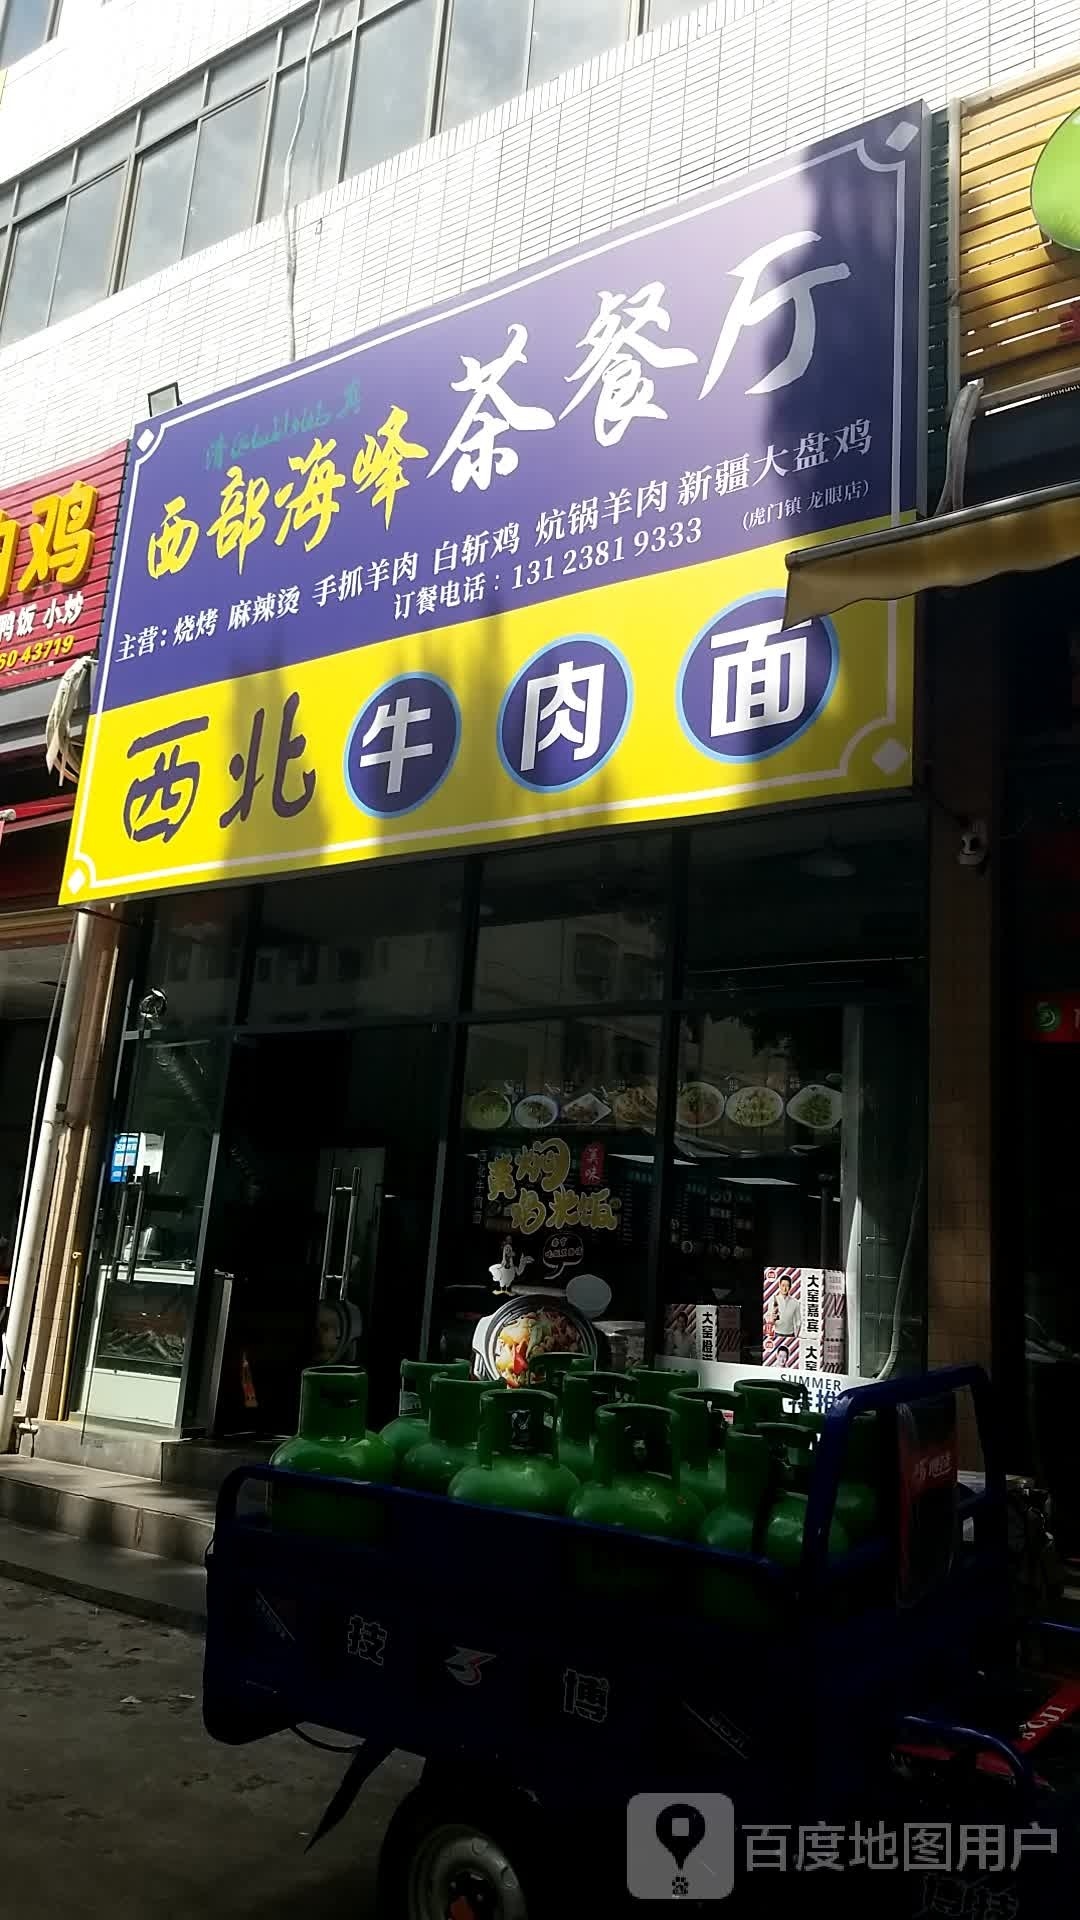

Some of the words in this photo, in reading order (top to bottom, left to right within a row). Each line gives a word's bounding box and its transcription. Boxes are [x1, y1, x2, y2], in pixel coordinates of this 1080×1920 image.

[0, 480, 97, 602] 鸡
[172, 607, 219, 647] 烧烤
[228, 585, 301, 631] 麻辣烫
[312, 551, 418, 607] 手抓羊肉
[433, 521, 521, 575] 白斩鸡
[535, 479, 668, 547] 炕锅羊肉
[677, 417, 873, 506] 新疆大盘鸡
[43, 591, 85, 630] 小炒
[780, 1373, 842, 1392] SUMMER
